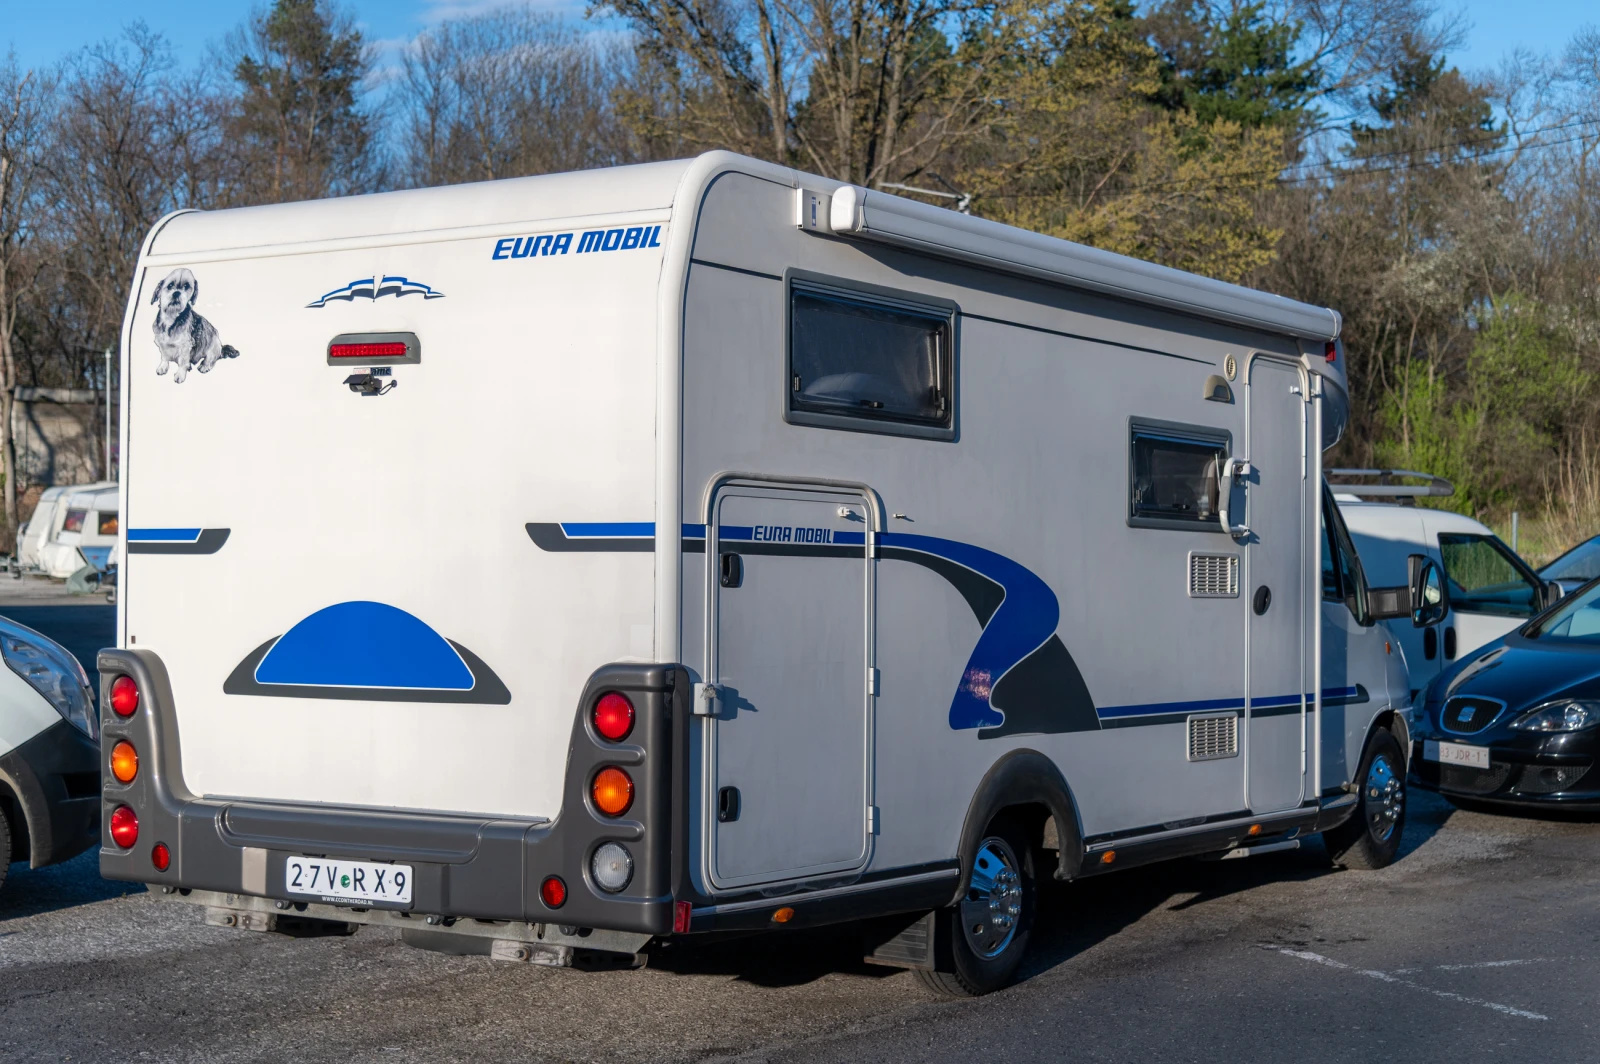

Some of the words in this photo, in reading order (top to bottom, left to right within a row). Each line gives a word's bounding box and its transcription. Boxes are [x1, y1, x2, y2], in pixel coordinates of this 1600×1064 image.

[492, 233, 574, 261] EURA
[576, 225, 662, 254] MOBIL
[753, 525, 792, 542] EURA
[794, 527, 832, 544] MOBIL
